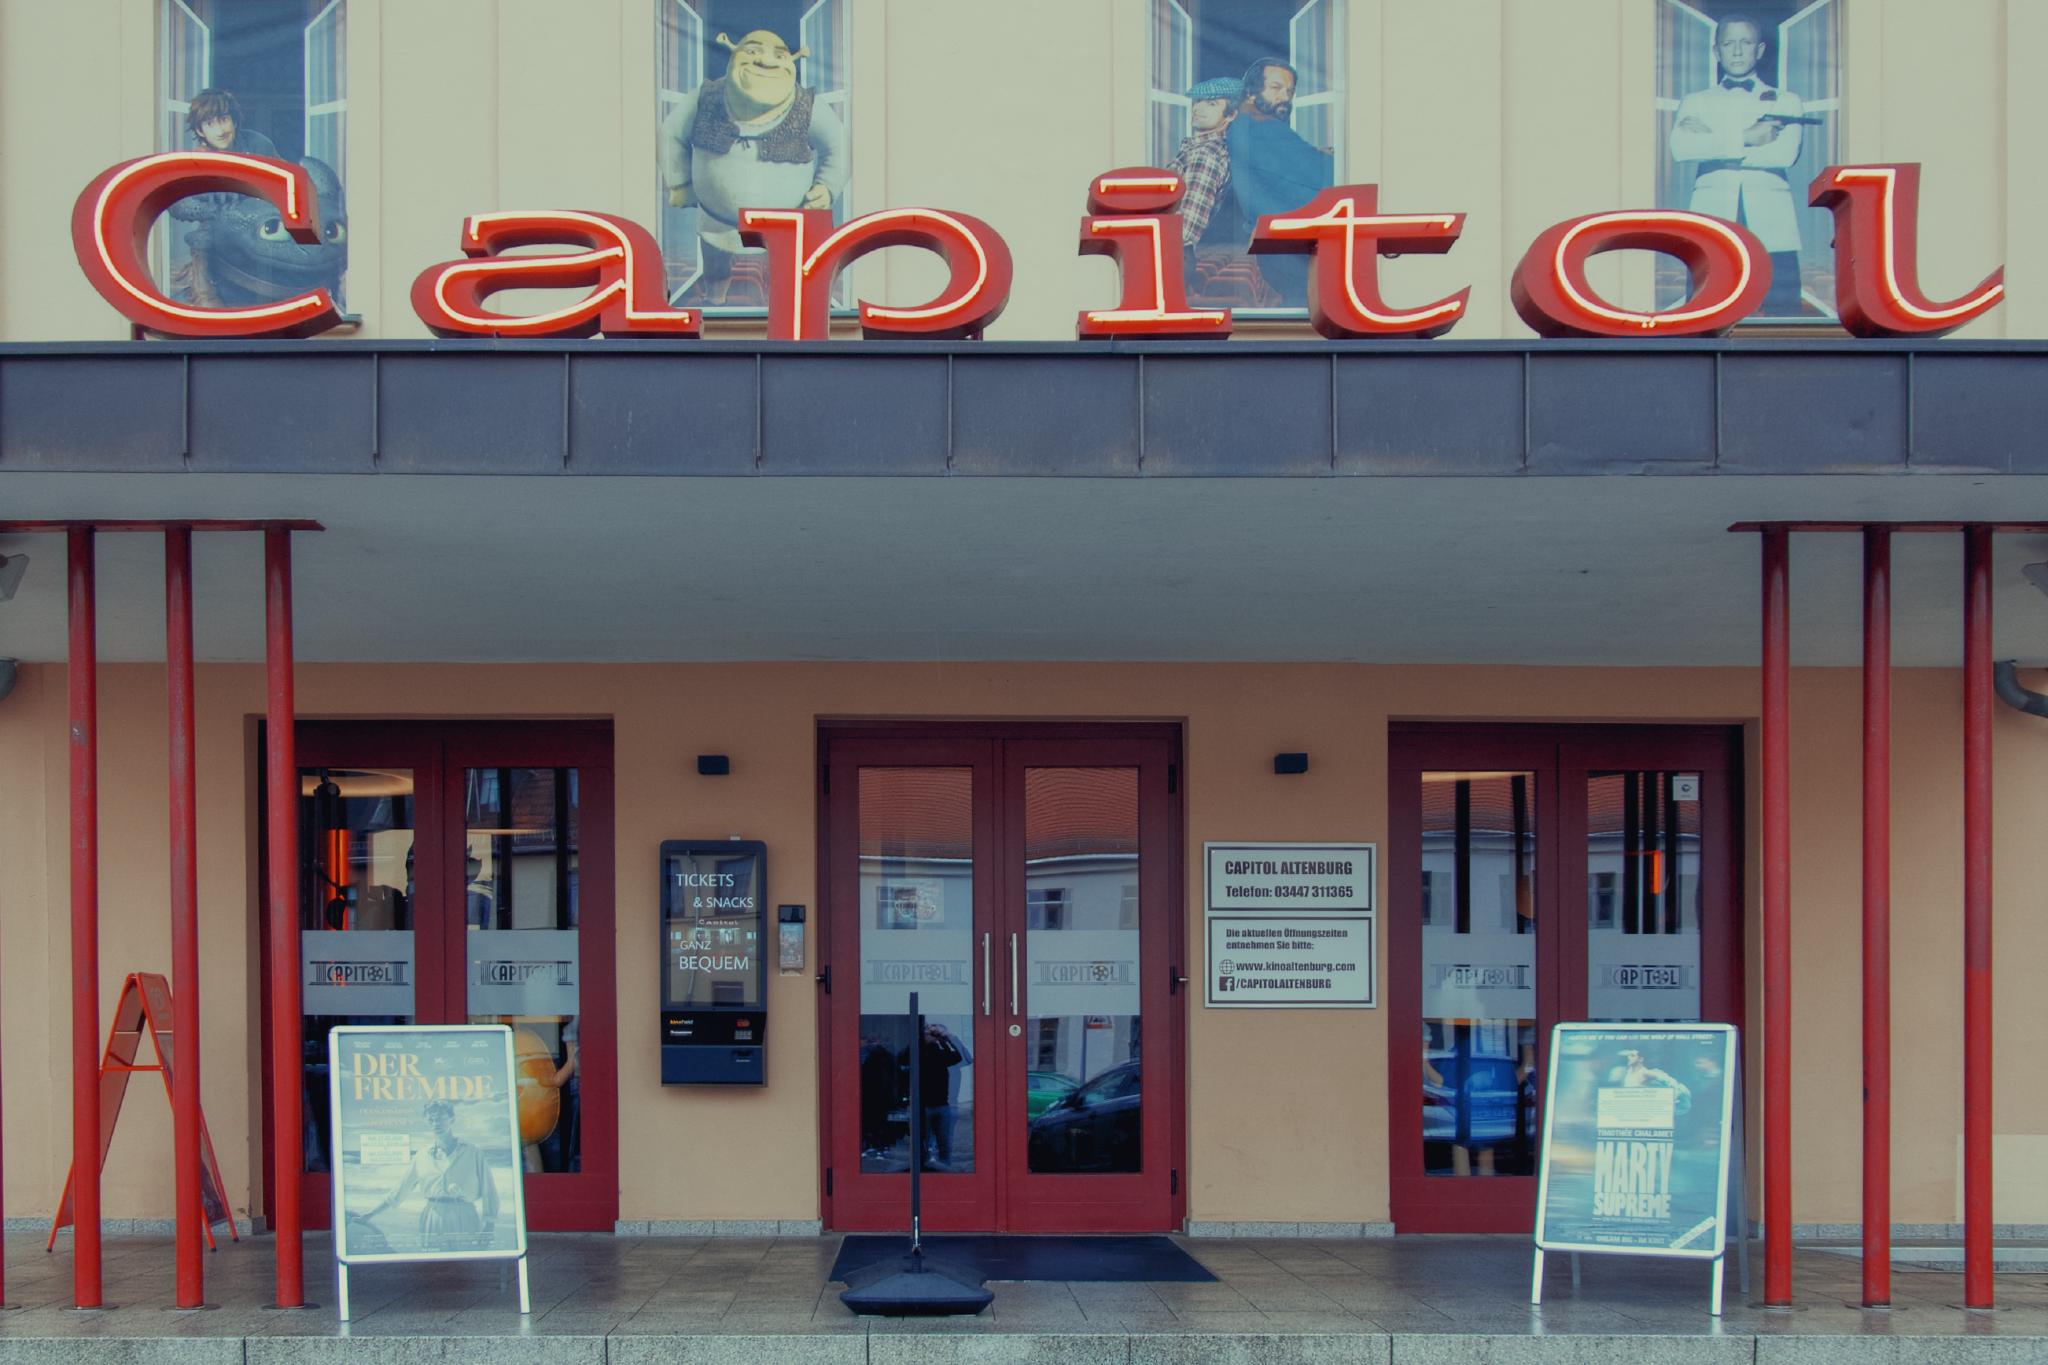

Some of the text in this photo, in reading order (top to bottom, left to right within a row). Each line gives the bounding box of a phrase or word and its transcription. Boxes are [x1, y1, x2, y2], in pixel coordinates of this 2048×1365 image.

[72, 150, 2005, 340] Capitol
[1225, 861, 1353, 875] CAPITOL ALTENBURG
[675, 874, 735, 888] TICKETS
[1226, 886, 1354, 898] Telefon: 03447 311365
[693, 896, 754, 908] & SNACKS
[1226, 927, 1348, 939] Die aktuellen Öffnungszeiten
[679, 940, 712, 950] GANZ
[1226, 941, 1314, 950] entnehmen Sie bitte:
[491, 965, 553, 981] CAPIT
[679, 956, 749, 973] BEQUEM
[884, 964, 950, 981] CAPITOL
[1051, 964, 1118, 981] CAPITOL
[1236, 961, 1355, 972] www.kinoaltenburg.com
[327, 965, 392, 982] CAPITOL
[1612, 968, 1678, 985] CAPITOL
[352, 1053, 422, 1077] DER
[354, 1075, 494, 1100] FREMDE
[1594, 1141, 1673, 1194] MARTY
[1593, 1192, 1672, 1218] SUPREME
